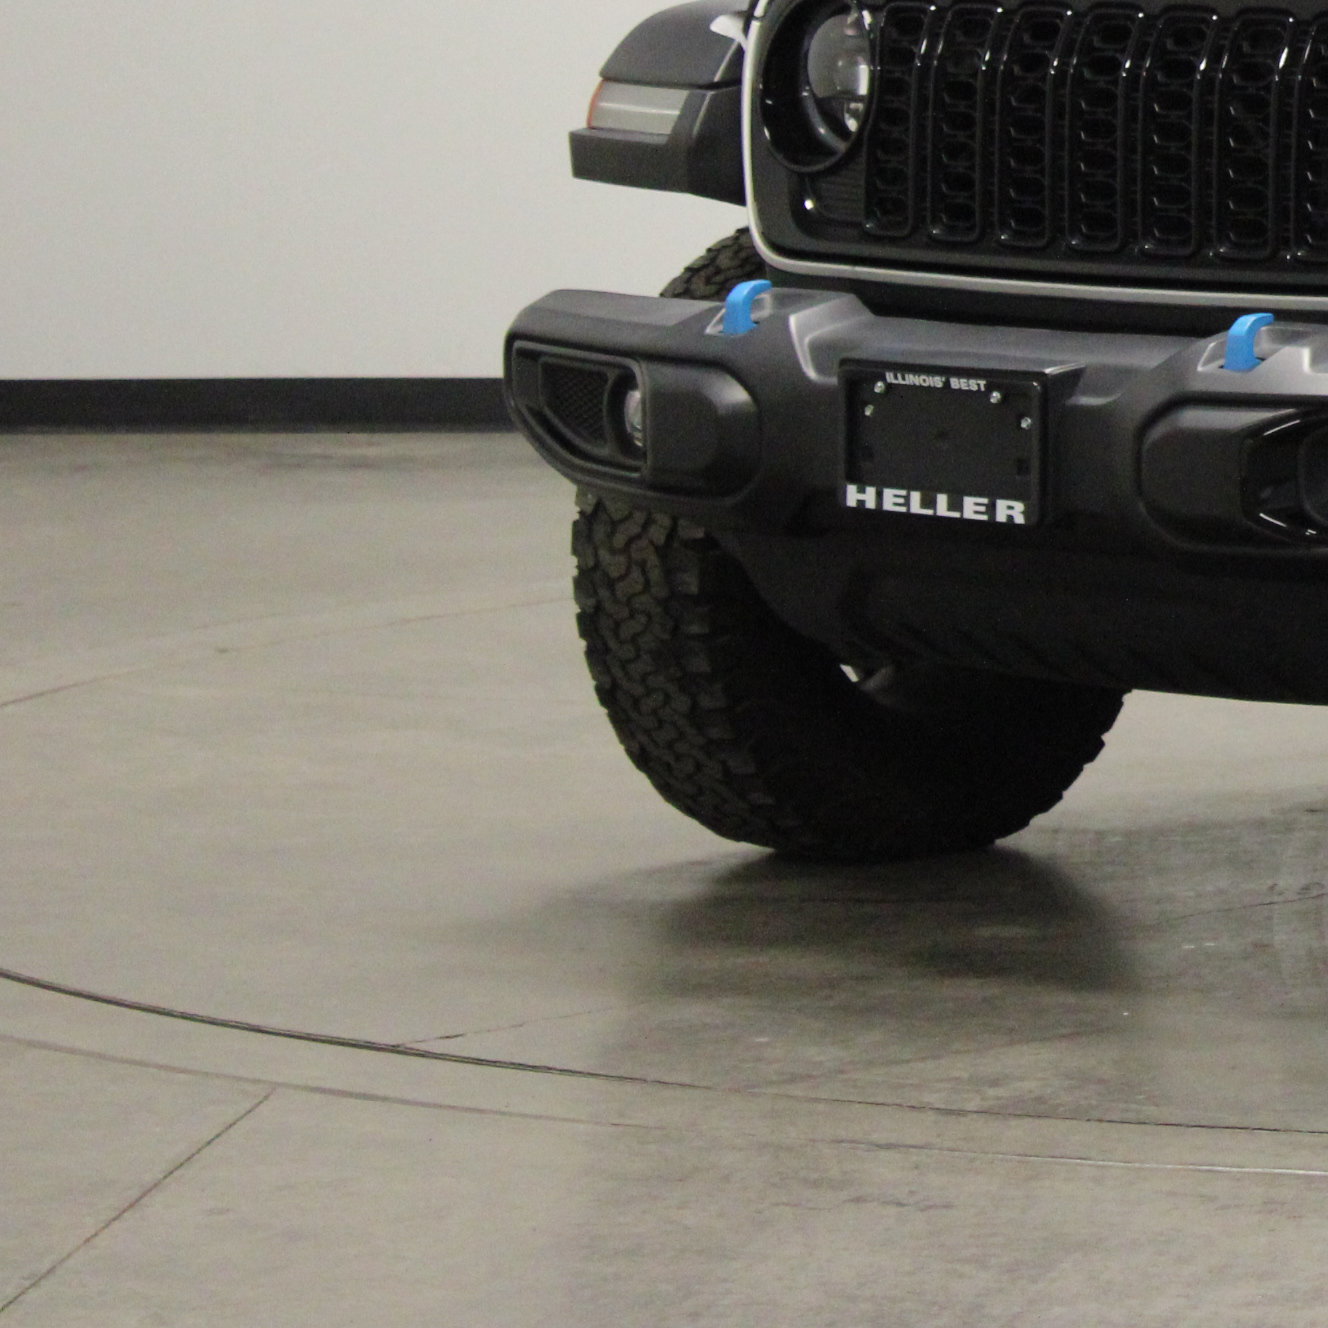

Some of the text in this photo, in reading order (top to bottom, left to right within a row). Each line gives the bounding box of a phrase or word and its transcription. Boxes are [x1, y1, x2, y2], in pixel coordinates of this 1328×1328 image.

[885, 371, 987, 391] ILLINOIS' BEST
[846, 484, 1025, 524] HELLER
